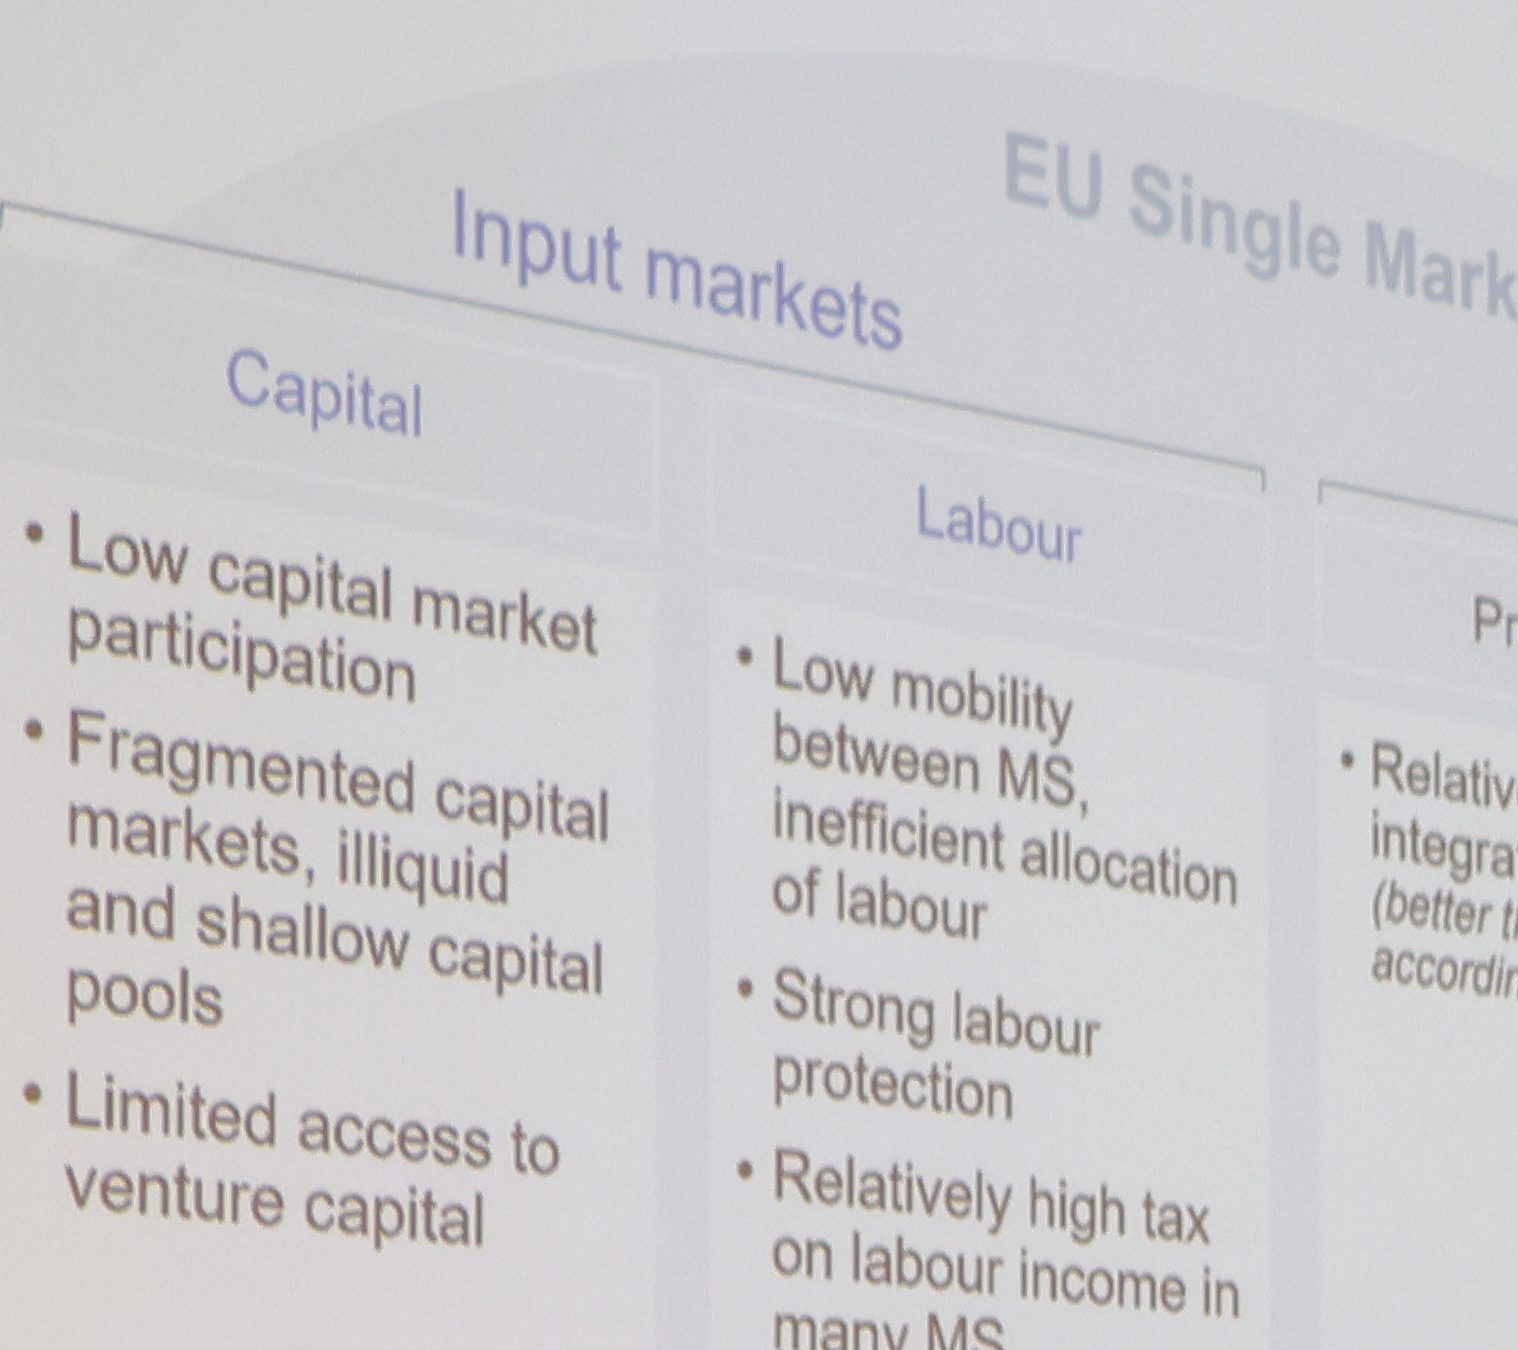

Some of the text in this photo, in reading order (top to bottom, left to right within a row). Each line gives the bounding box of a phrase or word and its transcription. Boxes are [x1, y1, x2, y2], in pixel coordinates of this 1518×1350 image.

[1005, 130, 1102, 219] EU
[1130, 163, 1341, 282] Single
[455, 188, 902, 351] Input markets
[227, 348, 421, 437] Capital
[918, 485, 1082, 563] Labour
[70, 511, 597, 656] Low capital market
[70, 607, 415, 702] participation
[775, 635, 1073, 747] Low mobility
[70, 708, 608, 842] Fragmented capital
[775, 710, 1087, 818] between MS,
[69, 803, 508, 907] markets, illiquid
[775, 786, 1237, 906] inefficient allocation
[67, 885, 602, 997] and shallow capital
[773, 866, 988, 940] of labour
[1373, 880, 1492, 935] (better
[69, 967, 223, 1026] pools
[774, 966, 1100, 1057] Strong labour
[68, 1069, 560, 1176] Limited access to
[775, 1054, 1012, 1119] protection
[65, 1165, 483, 1251] venture capital
[775, 1148, 1209, 1245] Relatively high tax
[773, 1230, 1239, 1318] on labour income in
